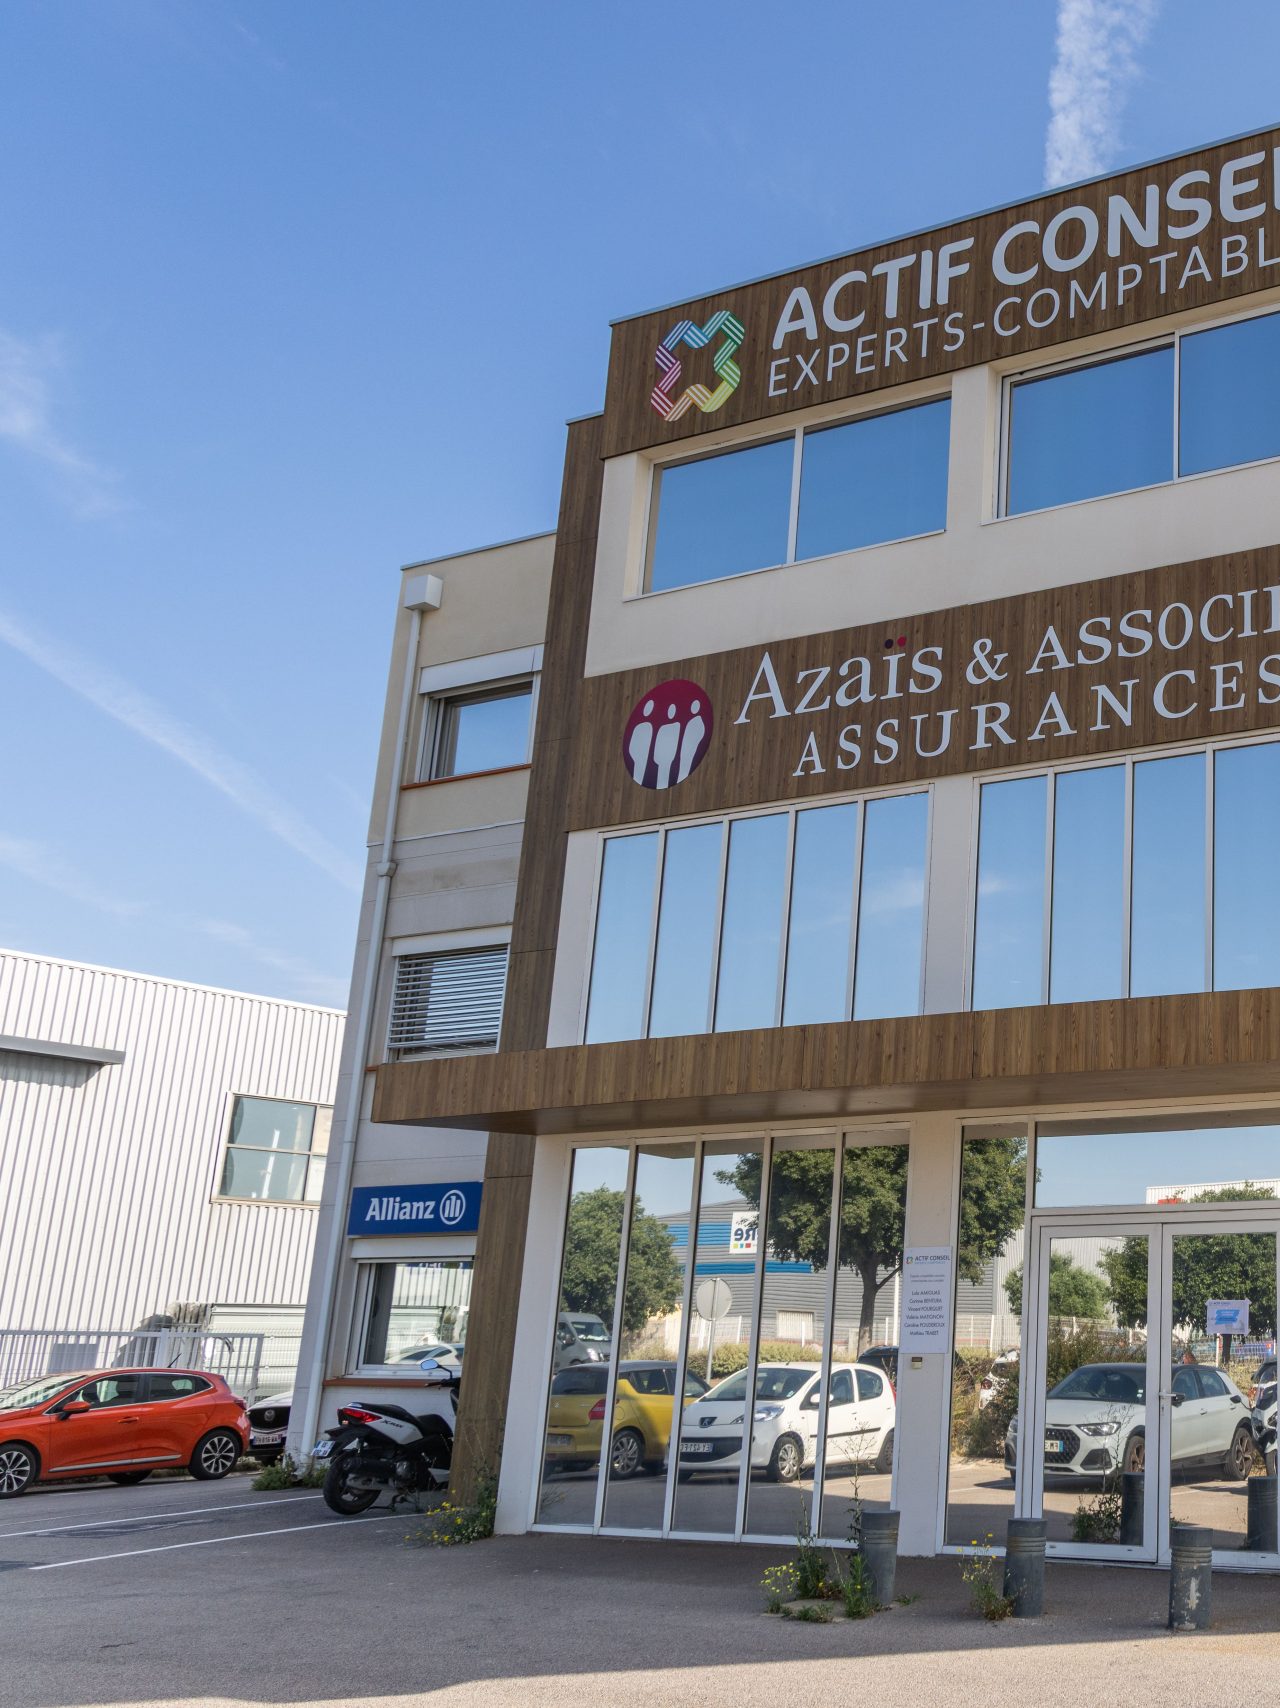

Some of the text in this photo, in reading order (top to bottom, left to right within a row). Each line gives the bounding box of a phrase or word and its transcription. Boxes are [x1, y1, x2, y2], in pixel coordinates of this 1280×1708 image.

[772, 236, 975, 350] ACTIF
[733, 636, 945, 725] Azaïs
[965, 637, 1008, 685] &
[365, 1196, 436, 1221] Allianz
